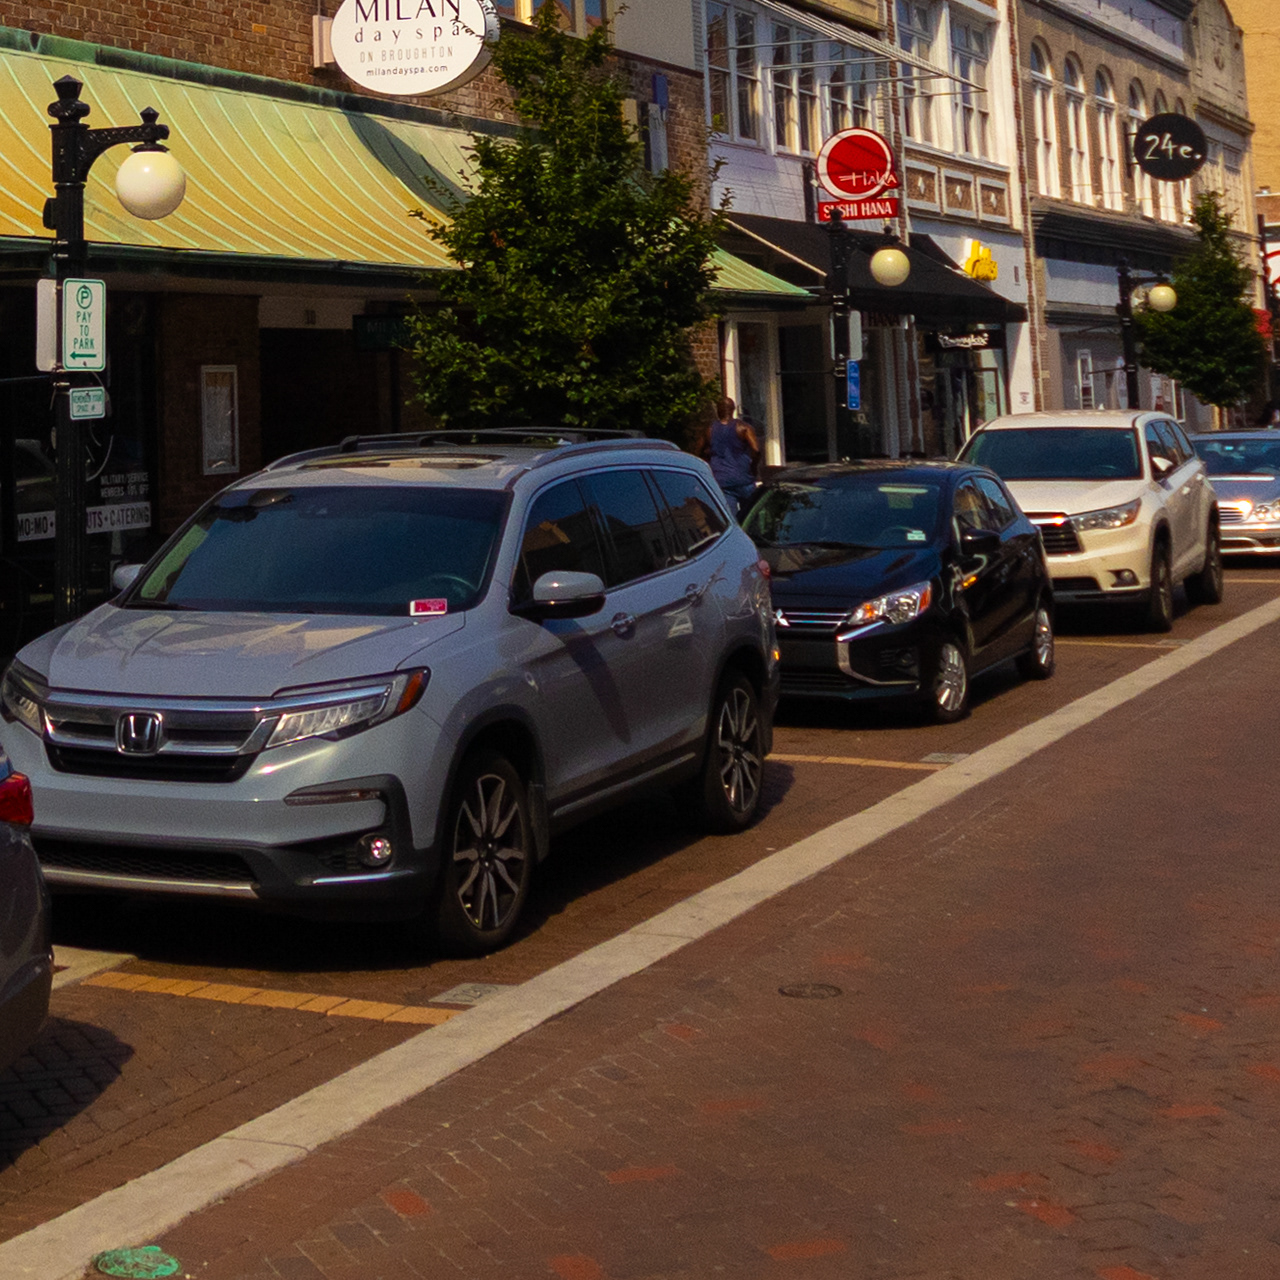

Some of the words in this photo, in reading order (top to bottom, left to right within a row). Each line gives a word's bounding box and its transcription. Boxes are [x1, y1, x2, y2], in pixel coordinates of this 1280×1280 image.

[355, 27, 401, 44] day
[415, 24, 460, 41] spa
[360, 51, 374, 63] ON
[381, 46, 453, 61] BROUGHTON
[366, 65, 448, 77] milandayspa.com
[823, 202, 858, 219] SSHI
[861, 201, 892, 216] HANA
[76, 311, 92, 323] PAY
[80, 324, 90, 336] TO
[73, 337, 95, 350] PARK
[110, 506, 151, 526] CATERING
